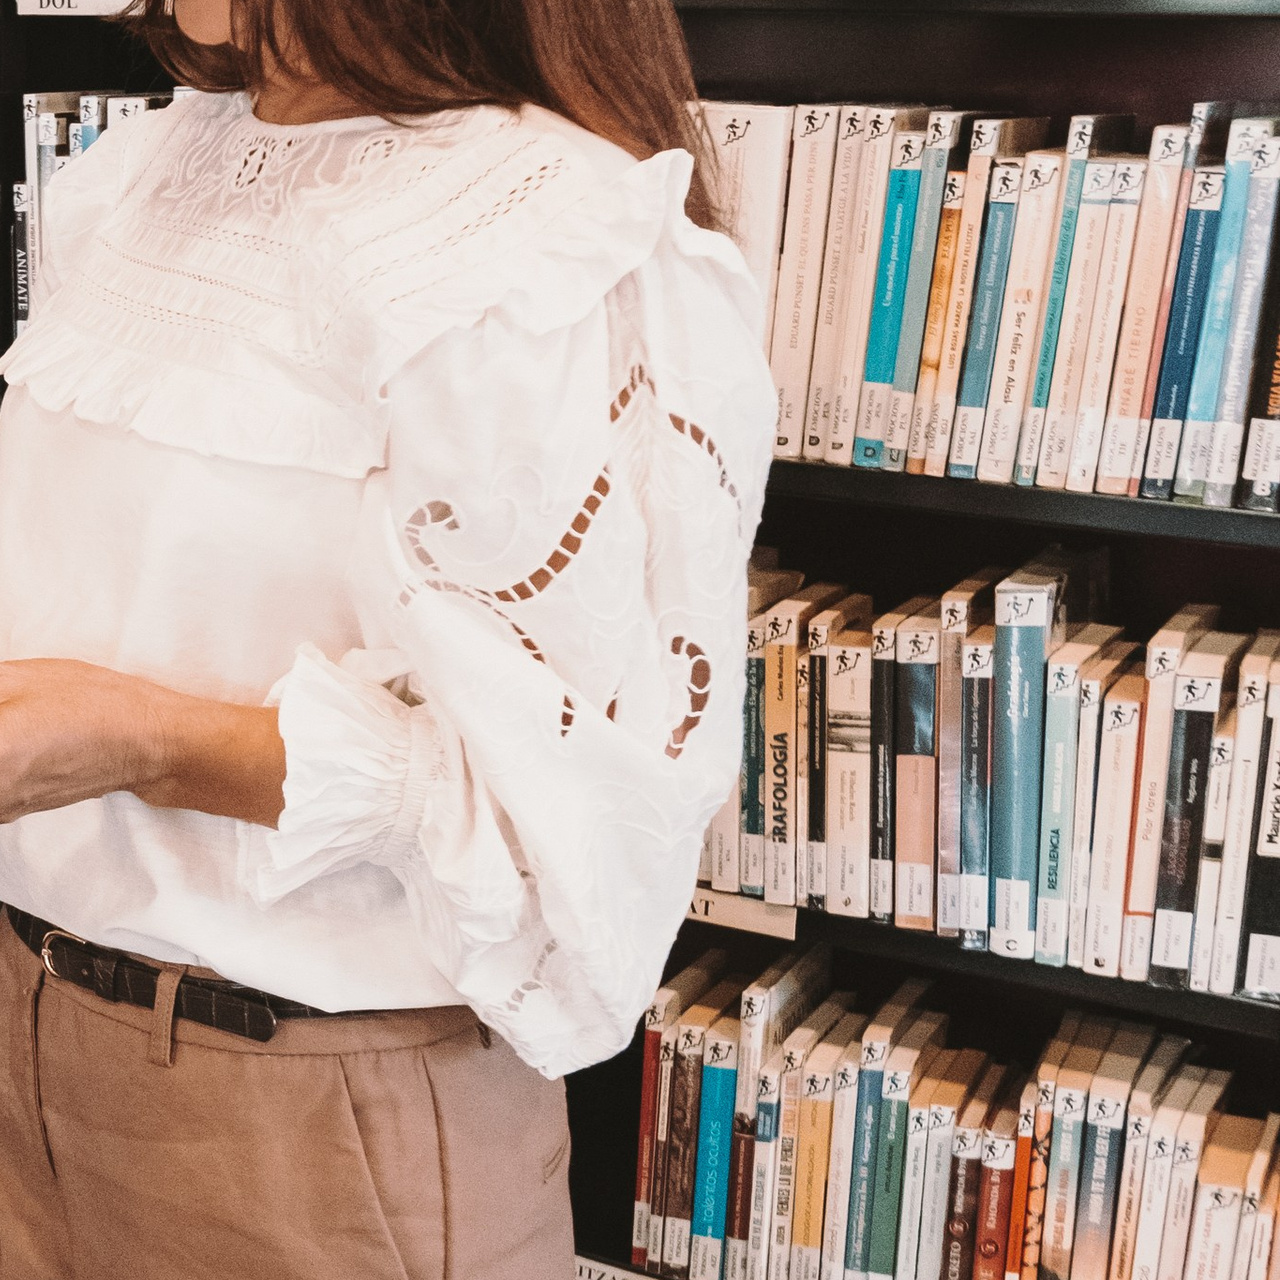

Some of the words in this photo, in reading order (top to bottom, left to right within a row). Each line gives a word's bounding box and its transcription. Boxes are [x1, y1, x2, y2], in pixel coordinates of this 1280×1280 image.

[1009, 330, 1022, 355] feliz
[1145, 781, 1156, 813] Varela
[1143, 817, 1154, 840] Pilar
[1045, 828, 1061, 890] RESILIENCIA
[701, 1170, 717, 1221] talentos
